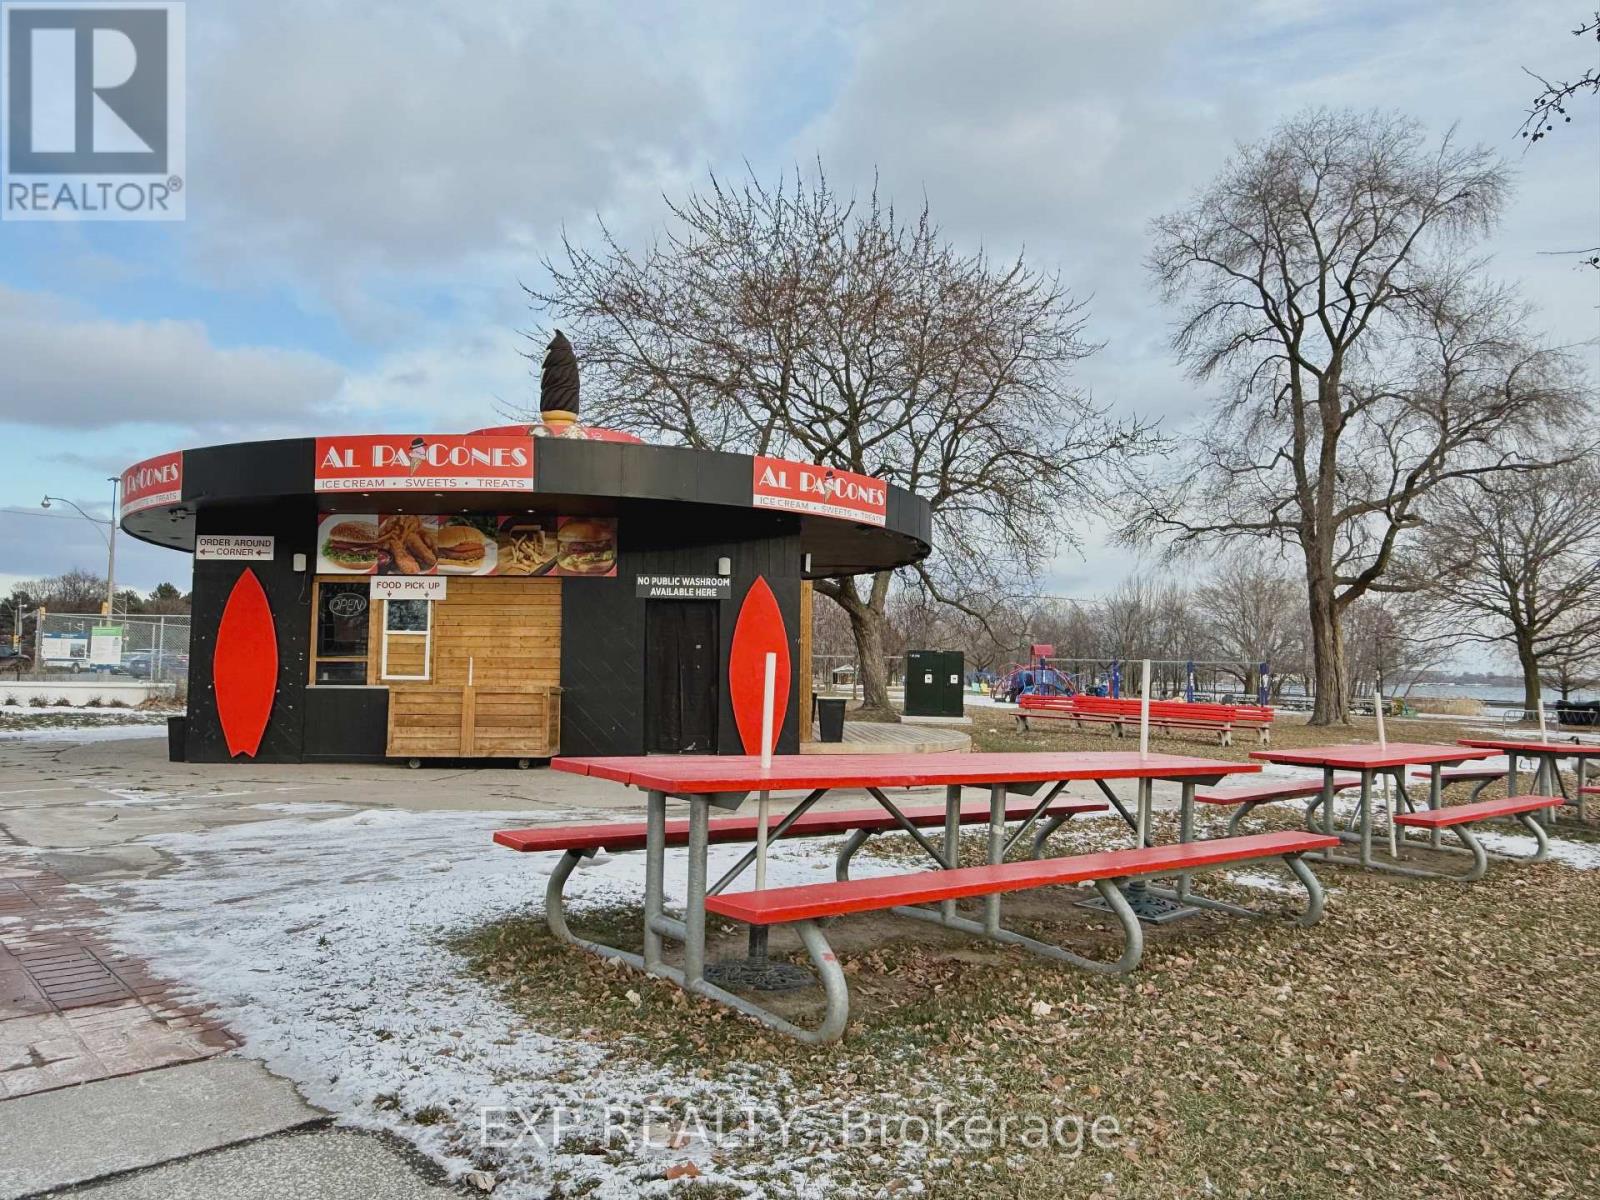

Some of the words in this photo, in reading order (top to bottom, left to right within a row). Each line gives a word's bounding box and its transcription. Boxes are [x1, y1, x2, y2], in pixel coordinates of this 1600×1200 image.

[321, 445, 360, 469] AL
[759, 465, 792, 490] AL
[322, 480, 340, 488] ICE
[343, 480, 385, 488] CREAM
[405, 479, 457, 488] SWEETS
[477, 479, 525, 488] TREATS
[760, 497, 776, 505] ICE
[778, 498, 809, 510] CREAM
[217, 548, 254, 556] CORNER
[376, 581, 402, 589] FOOD
[428, 581, 440, 590] UP
[637, 577, 650, 585] NO
[651, 577, 680, 586] PUBLIC
[681, 578, 730, 586] WASHROOM
[650, 588, 694, 596] AVAILABLE
[695, 588, 717, 597] HERE
[333, 599, 362, 610] OPEN
